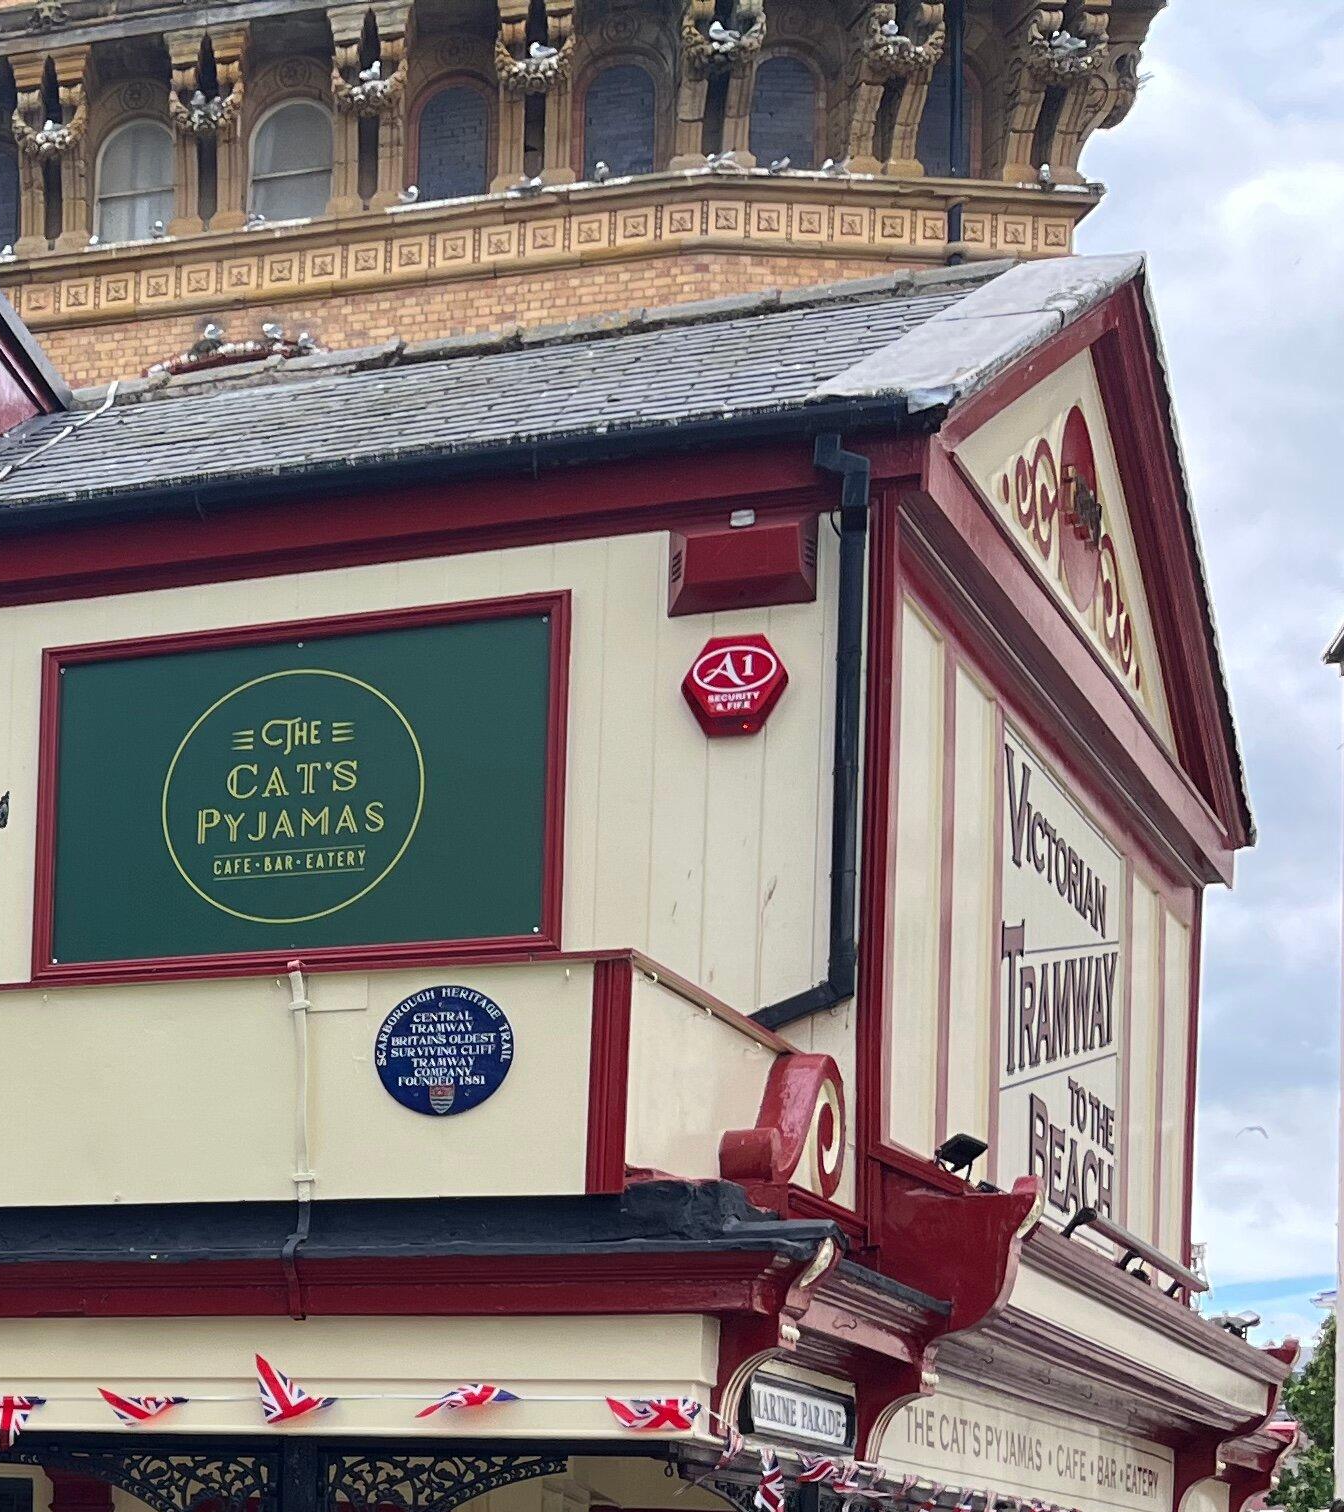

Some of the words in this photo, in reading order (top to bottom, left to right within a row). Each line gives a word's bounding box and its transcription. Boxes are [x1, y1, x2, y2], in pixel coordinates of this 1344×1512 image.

[703, 652, 754, 686] A1
[226, 758, 358, 799] CAT'S
[197, 801, 385, 844] PYJAMAS
[1004, 743, 1107, 939] VICTORIAN
[213, 856, 251, 875] CAFE
[264, 853, 293, 871] BAR
[306, 848, 366, 868] EATERY
[1001, 918, 1118, 1075] TRAMWAY
[376, 990, 435, 1066] SCARBOROUGH
[442, 987, 502, 1020] HERITAGE
[498, 1023, 512, 1063] TRAIL
[410, 1020, 474, 1034] TRAMWAY
[413, 1010, 473, 1023] CENTRAL
[390, 1046, 457, 1058] SURVIVING
[460, 1044, 496, 1055] CLIFF
[449, 1033, 496, 1044] OLDEST
[398, 1076, 454, 1086] FOUNDED
[459, 1075, 485, 1085] 1881
[411, 1057, 476, 1068] TRAMWAY
[414, 1067, 472, 1078] COMPANY
[1068, 1076, 1087, 1128] TO
[1088, 1093, 1114, 1155] THE
[1029, 1091, 1113, 1221] BEACH
[751, 1389, 798, 1428] MARINE
[801, 1400, 843, 1438] PARADE
[905, 1405, 935, 1448] THE
[939, 1415, 981, 1456] CAT'S
[985, 1425, 1043, 1473] PYJAMAS
[1056, 1450, 1086, 1482] CAFE
[1097, 1460, 1117, 1486] BAR
[1125, 1464, 1159, 1500] EATERY
